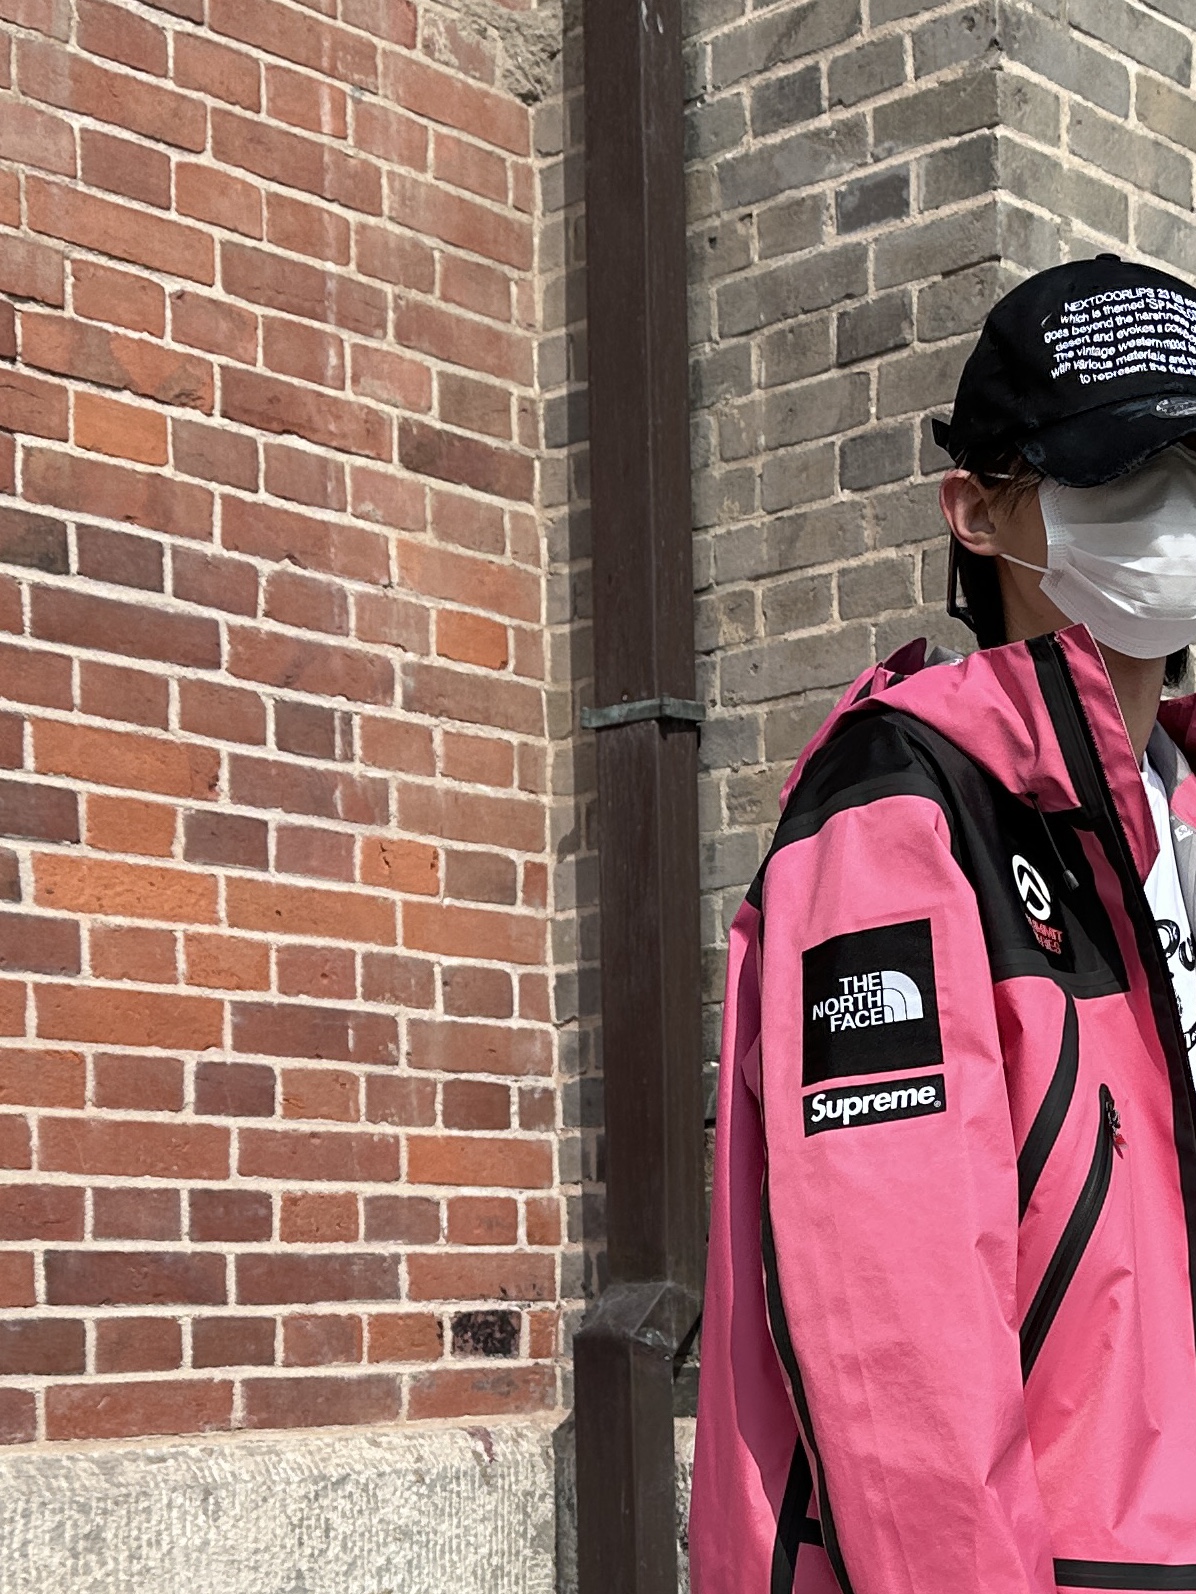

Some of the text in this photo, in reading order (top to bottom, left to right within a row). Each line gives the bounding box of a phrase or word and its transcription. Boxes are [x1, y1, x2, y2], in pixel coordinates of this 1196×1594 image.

[1061, 312, 1089, 324] which
[1103, 299, 1145, 315] themed
[1044, 328, 1069, 343] goes
[1072, 317, 1114, 335] beyond
[1115, 315, 1133, 326] the
[1093, 329, 1114, 342] and
[1116, 323, 1155, 339] evokes
[1053, 350, 1074, 362] The
[1076, 345, 1116, 359] vintage
[1051, 362, 1071, 379] with
[1073, 359, 1113, 370] various
[1080, 373, 1091, 384] to
[839, 971, 881, 995] THE
[812, 990, 882, 1021] NORTH
[830, 1007, 884, 1033] FACE
[810, 1085, 937, 1126] Supreme
